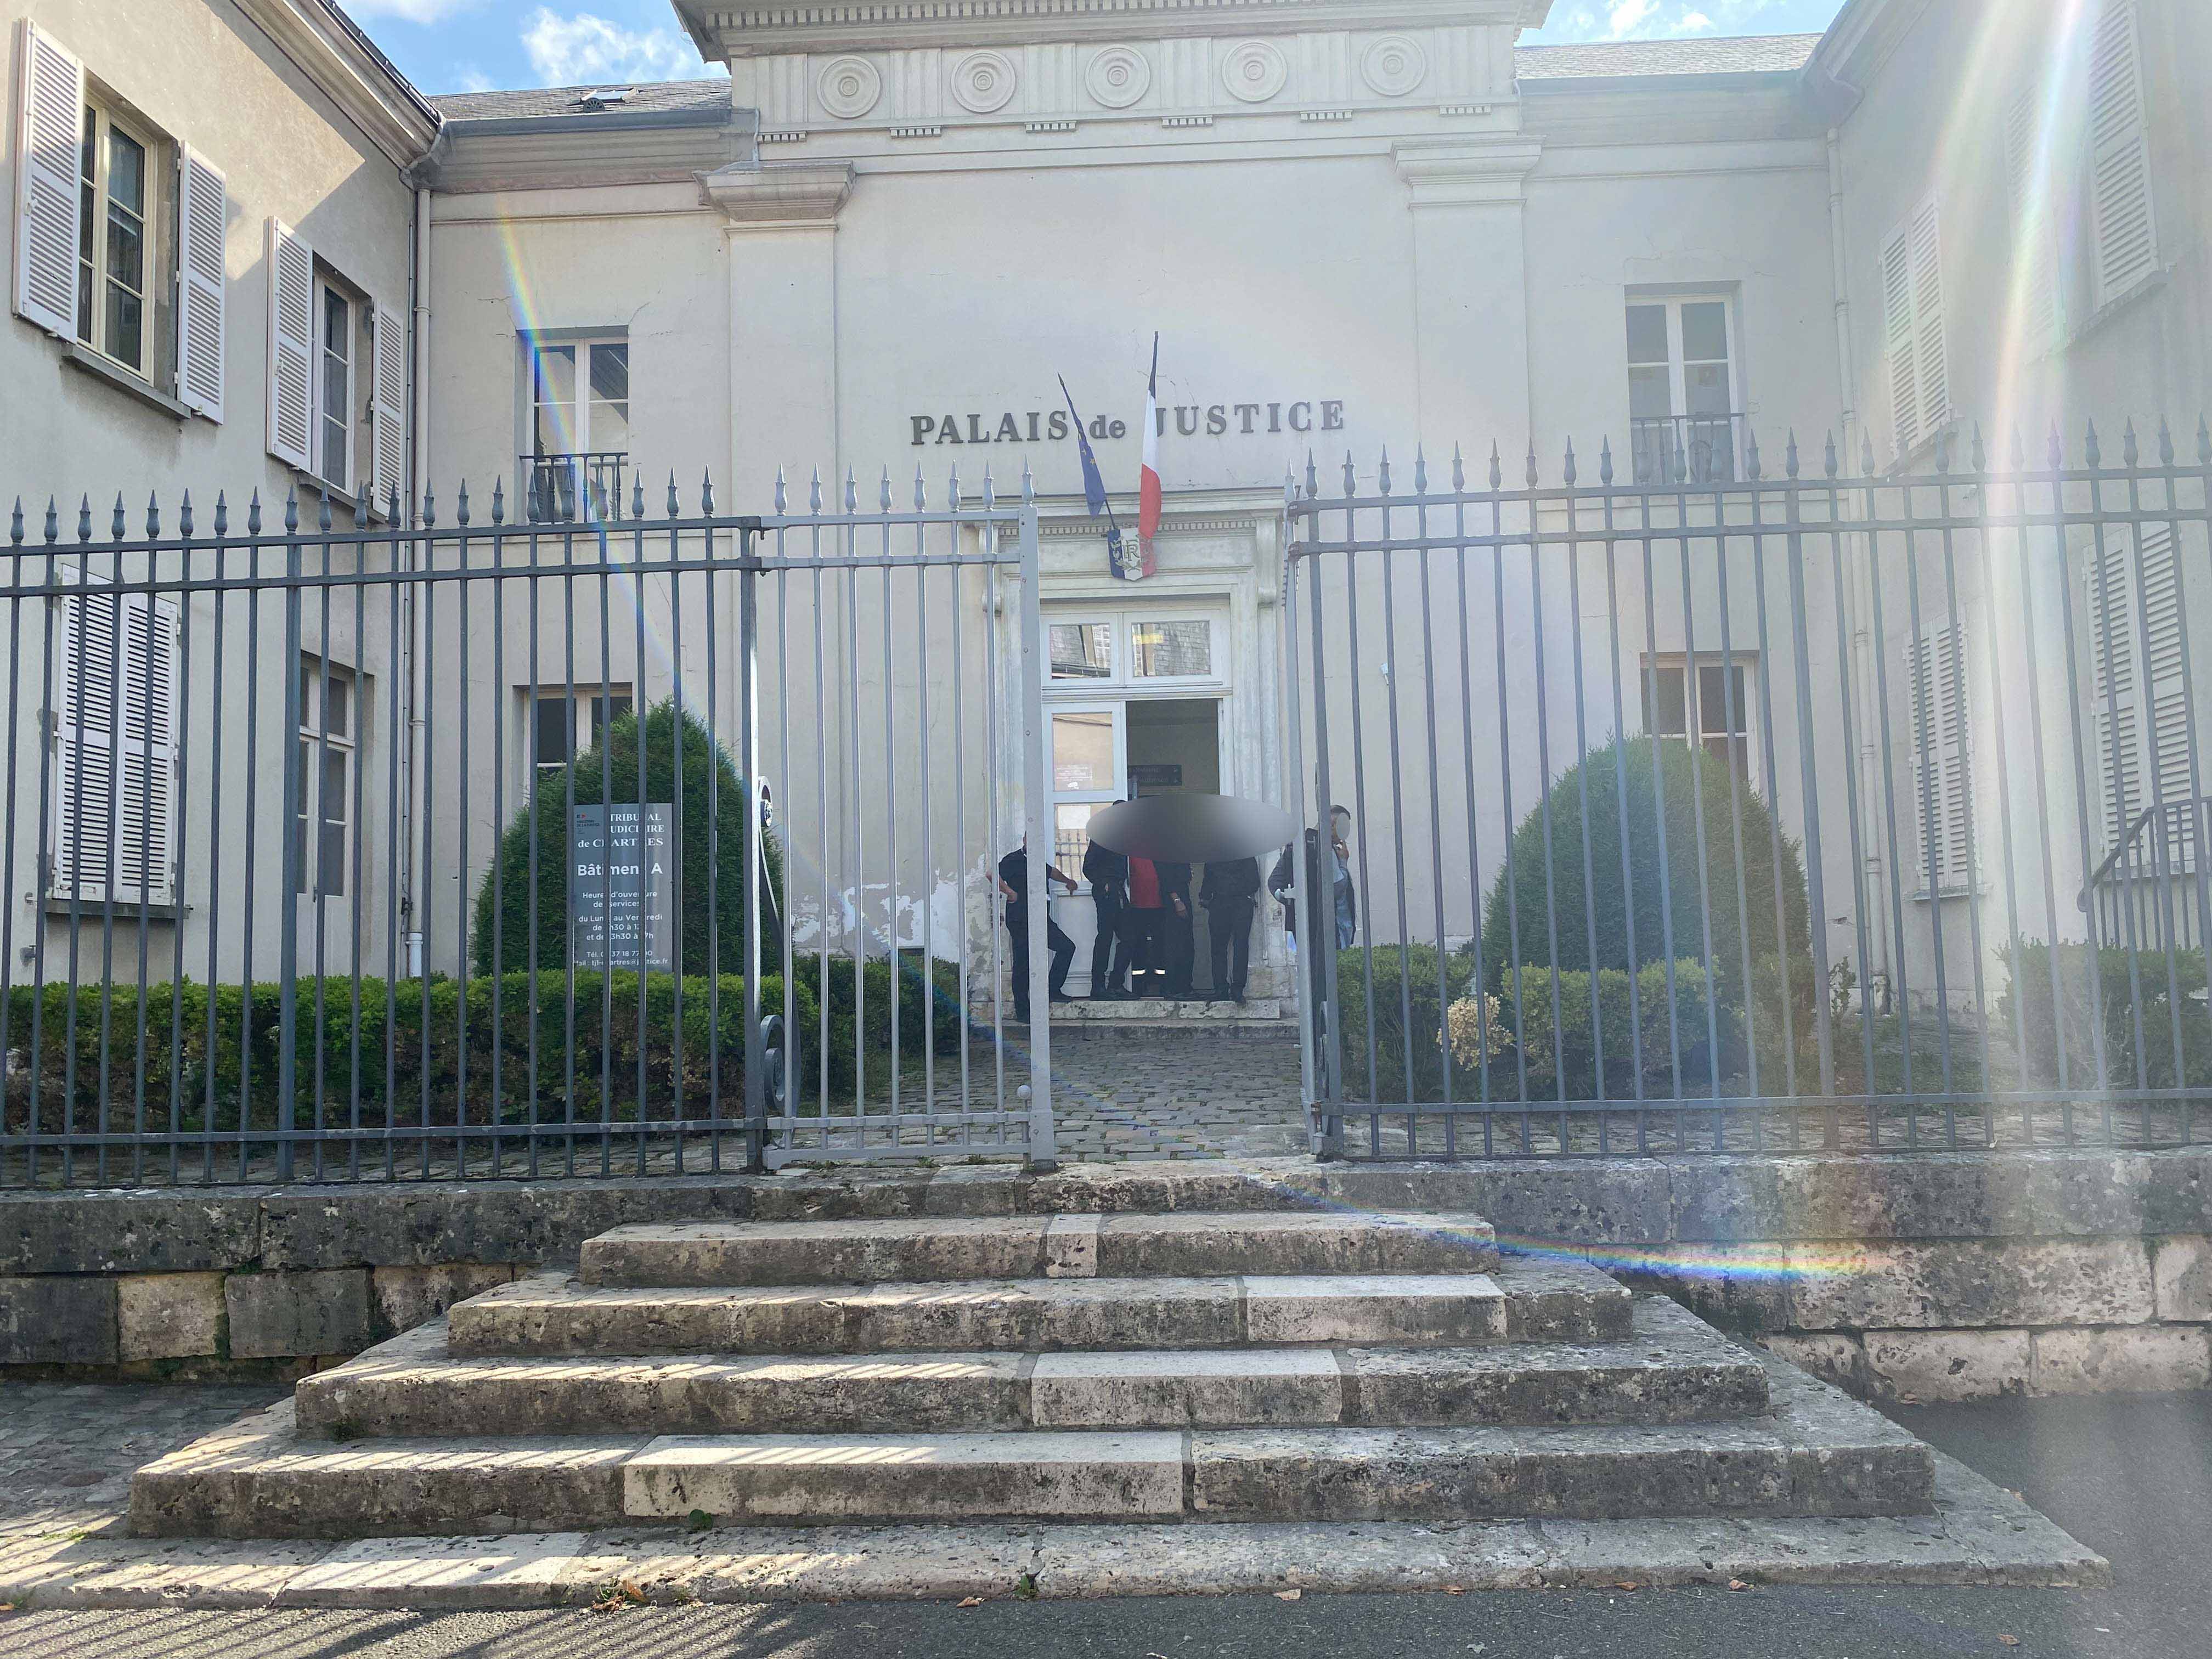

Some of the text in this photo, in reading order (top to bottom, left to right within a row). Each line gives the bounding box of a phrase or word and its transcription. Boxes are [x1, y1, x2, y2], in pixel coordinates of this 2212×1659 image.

[910, 410, 1068, 445] PALAIS
[1089, 415, 1126, 439] de
[610, 813, 662, 821] TRIBUAL
[609, 825, 665, 833] UDICIIRE
[592, 838, 663, 847] CARTES
[578, 862, 663, 876] Bâtimen A
